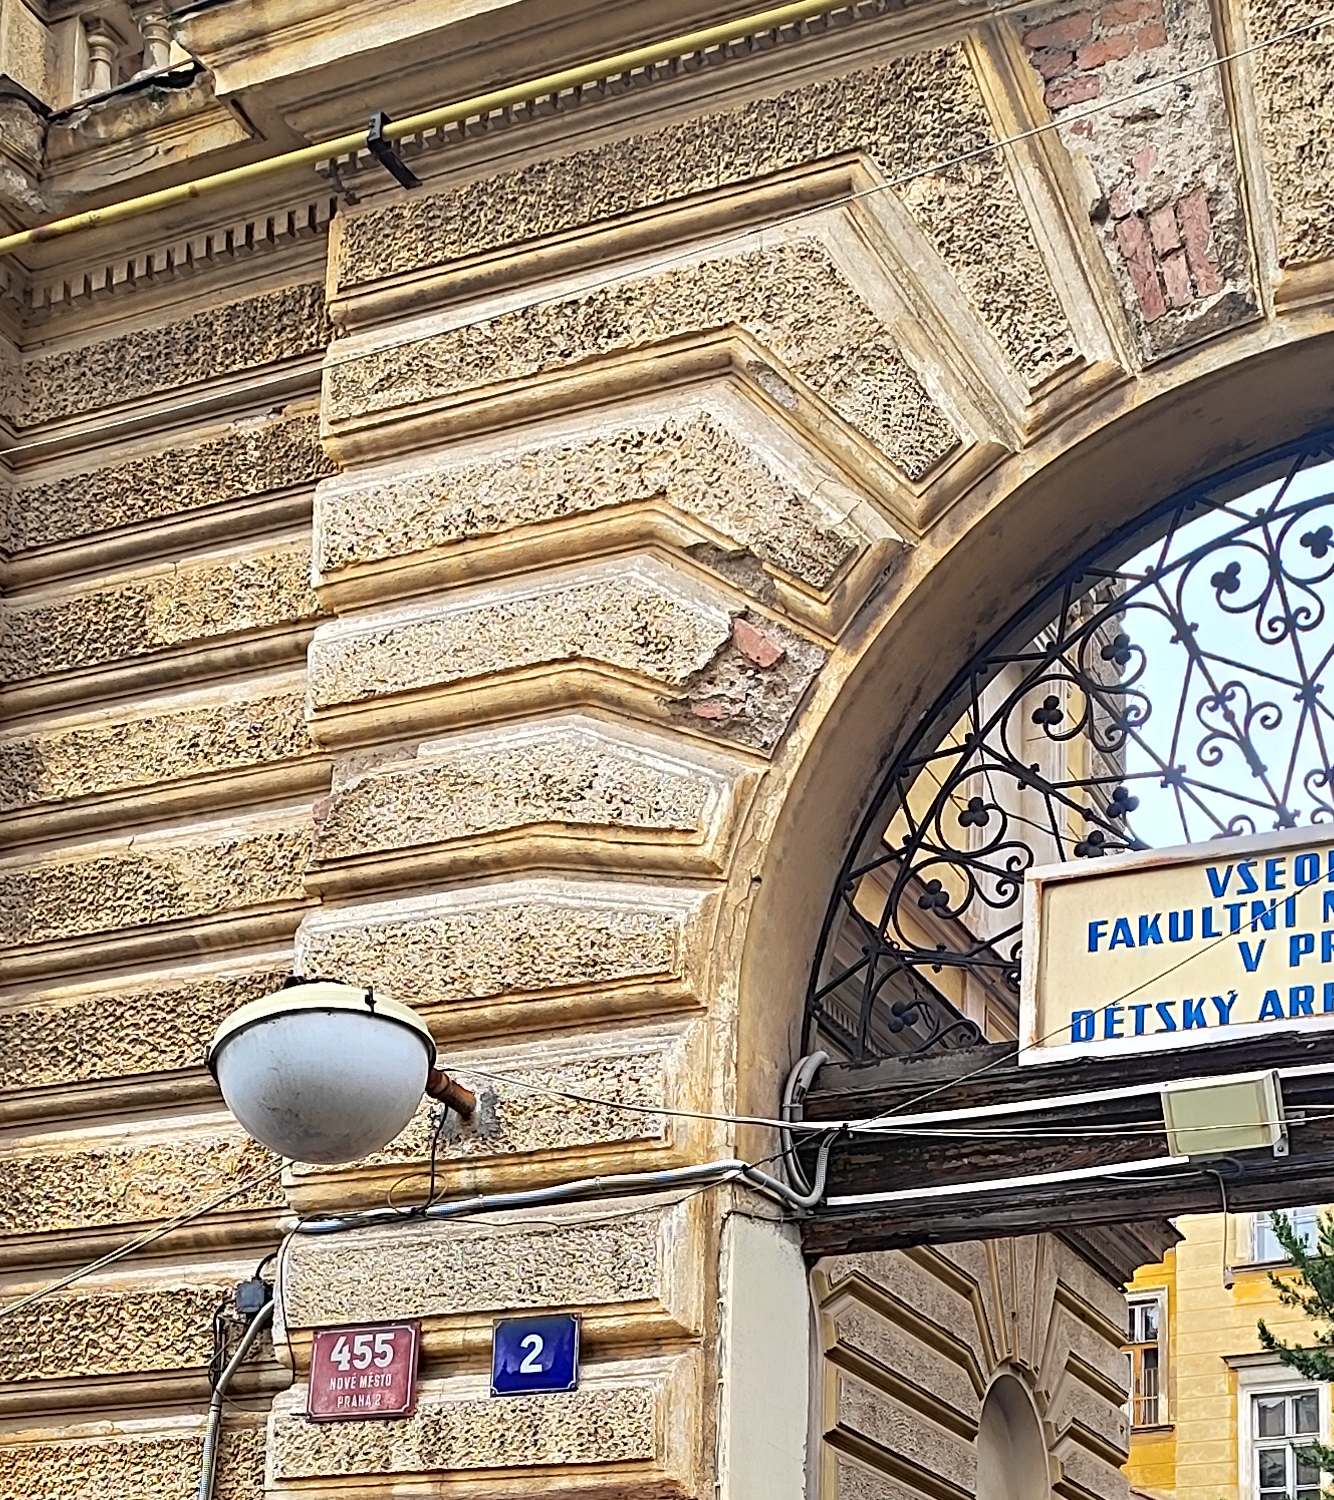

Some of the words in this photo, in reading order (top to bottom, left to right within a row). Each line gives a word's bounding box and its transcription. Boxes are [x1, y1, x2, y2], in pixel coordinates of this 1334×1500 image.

[1238, 938, 1265, 973] V
[1071, 990, 1239, 1043] DĚTSKÝ
[330, 1332, 395, 1371] 455
[519, 1334, 544, 1374] 2
[329, 1373, 357, 1389] NOVÉ
[360, 1371, 392, 1388] MĚSTO
[337, 1394, 372, 1408] PRAHA
[374, 1394, 382, 1406] 2
